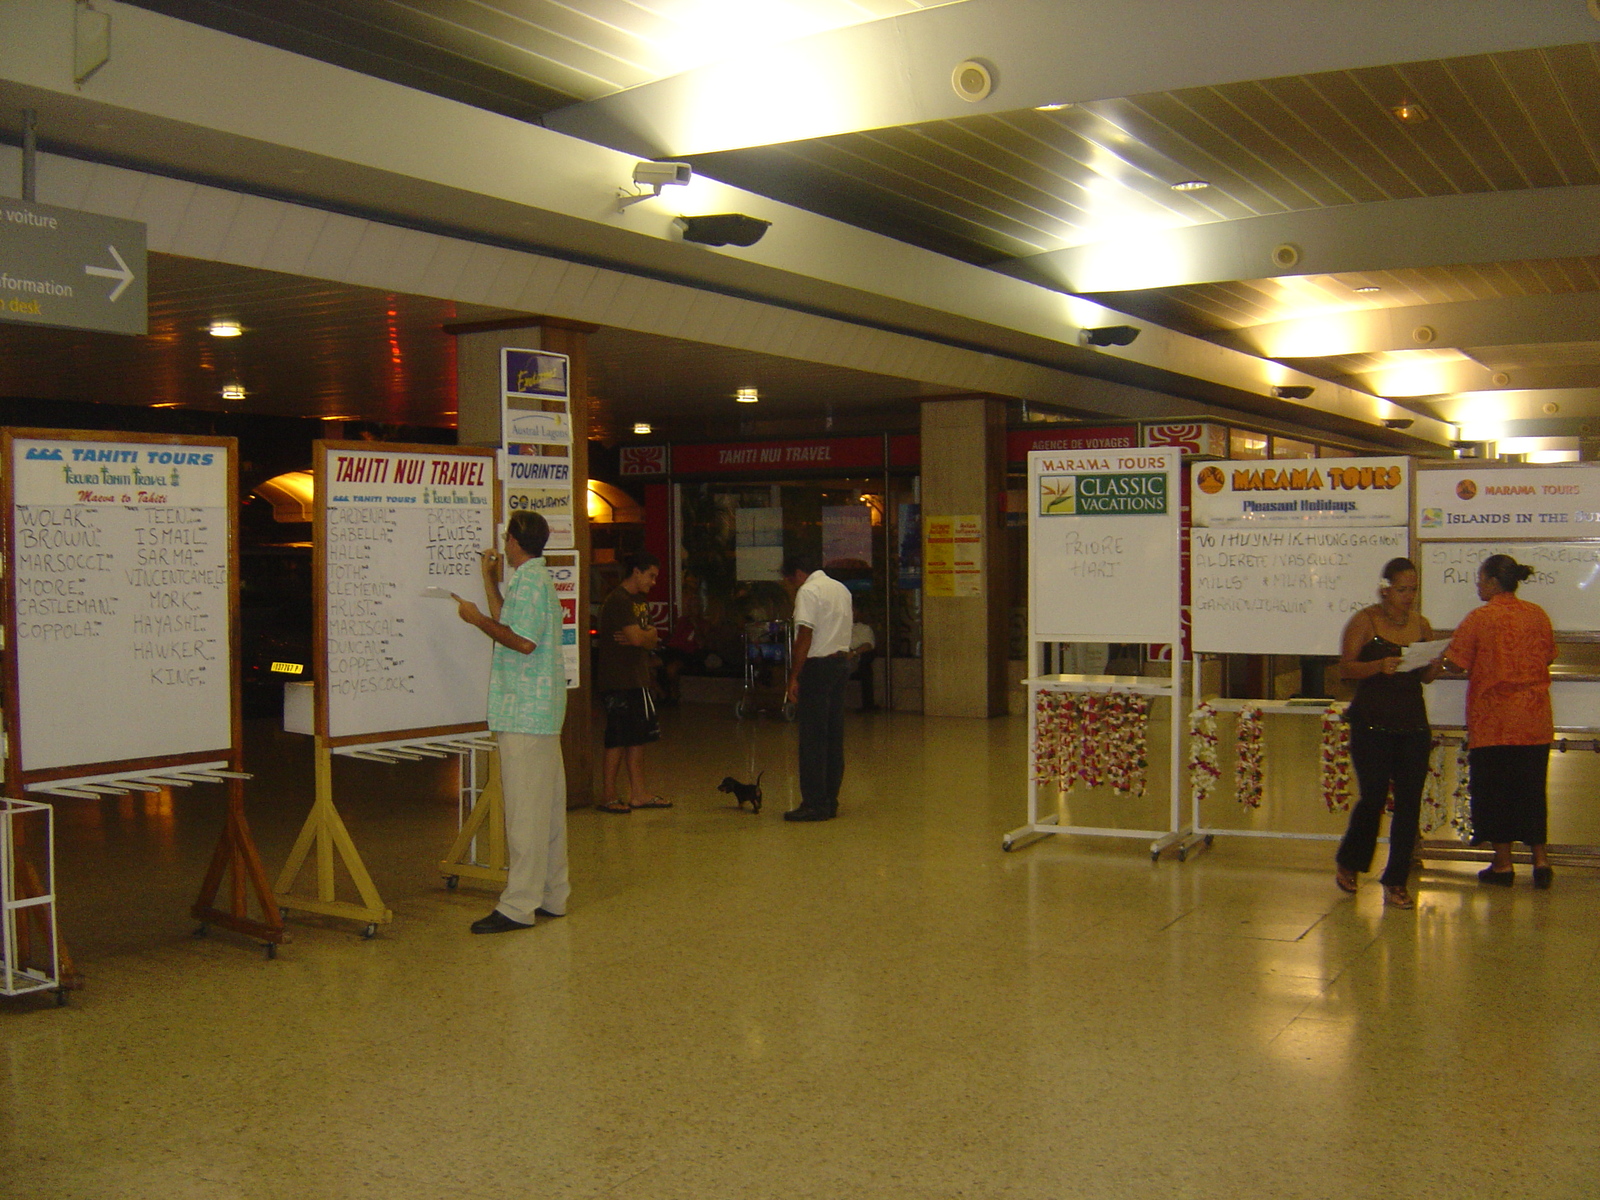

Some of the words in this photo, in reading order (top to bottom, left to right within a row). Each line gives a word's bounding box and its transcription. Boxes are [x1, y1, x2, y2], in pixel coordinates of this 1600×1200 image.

[7, 209, 58, 229] voiture
[0, 272, 73, 297] formation
[9, 297, 42, 315] desk
[512, 424, 539, 437] Austral
[1032, 438, 1068, 450] AGENCE
[1071, 438, 1083, 449] DE
[1086, 437, 1130, 448] VOYAGES
[72, 448, 138, 464] TAHITI
[147, 451, 214, 466] TOURS
[719, 448, 758, 464] TAHITI
[760, 447, 782, 463] NUI
[786, 446, 832, 461] TRAVEL
[1042, 459, 1110, 471] MARAMA
[1117, 457, 1166, 470] TOURS
[336, 456, 389, 484] TAHITI
[393, 458, 425, 485] NUI
[430, 460, 485, 487] TRAVEL
[510, 462, 569, 480] TOURINTER
[1231, 467, 1325, 492] MARAMA
[1327, 465, 1403, 490] TOURS
[1080, 477, 1163, 496] CLASSIC
[1484, 485, 1537, 496] MARAMA
[1541, 485, 1580, 496] TOURS
[121, 492, 132, 503] to
[1081, 497, 1165, 511] VACATIONS
[1243, 500, 1298, 512] Pleasant
[429, 525, 476, 542] LEWIS
